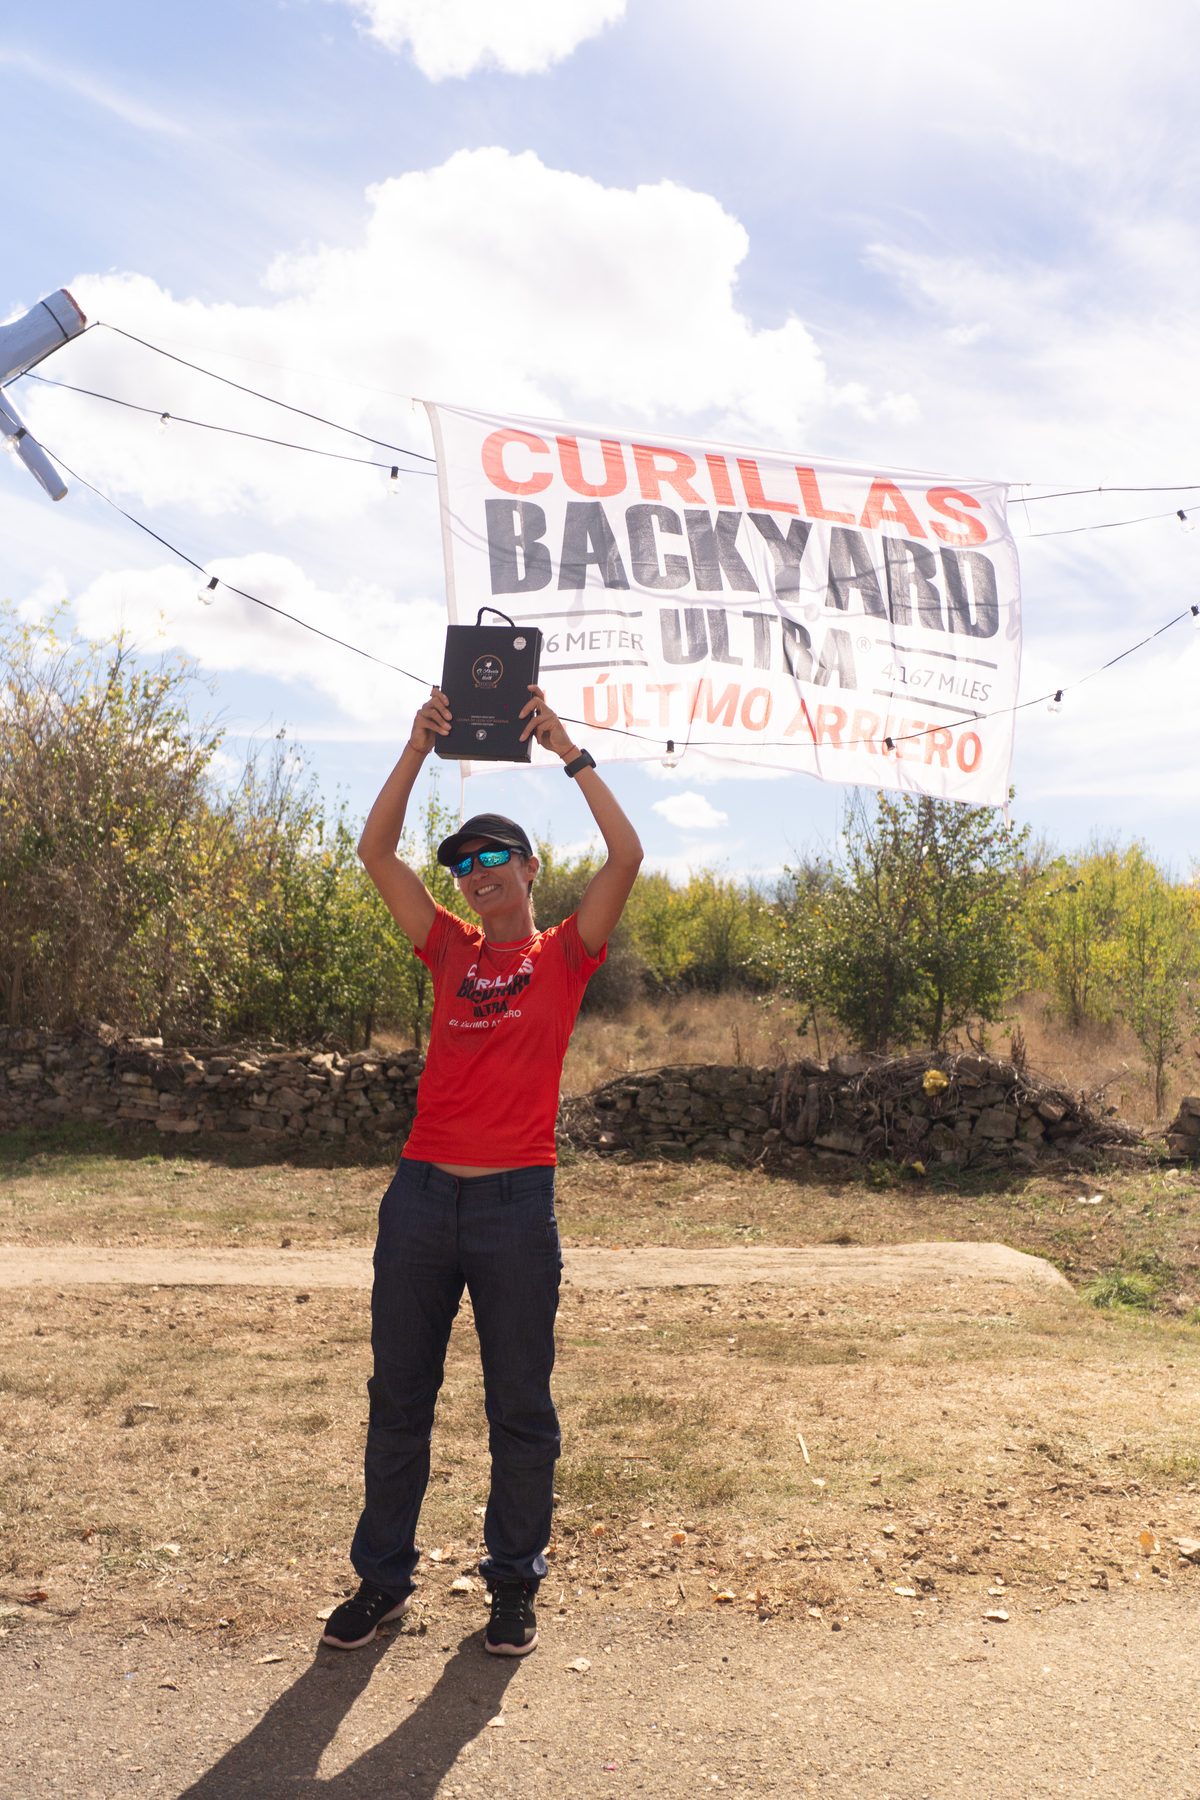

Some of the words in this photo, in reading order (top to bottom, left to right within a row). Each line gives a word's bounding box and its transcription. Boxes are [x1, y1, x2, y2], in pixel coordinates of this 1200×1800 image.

[481, 428, 988, 546] CURILLAS
[485, 498, 999, 638] BACKYARD
[566, 629, 644, 652] METER
[660, 608, 858, 690] ULTRA
[881, 662, 934, 687] 4.167
[938, 673, 993, 702] MILES
[583, 673, 772, 733] ÚLTIMO
[783, 699, 983, 773] ARRIERO
